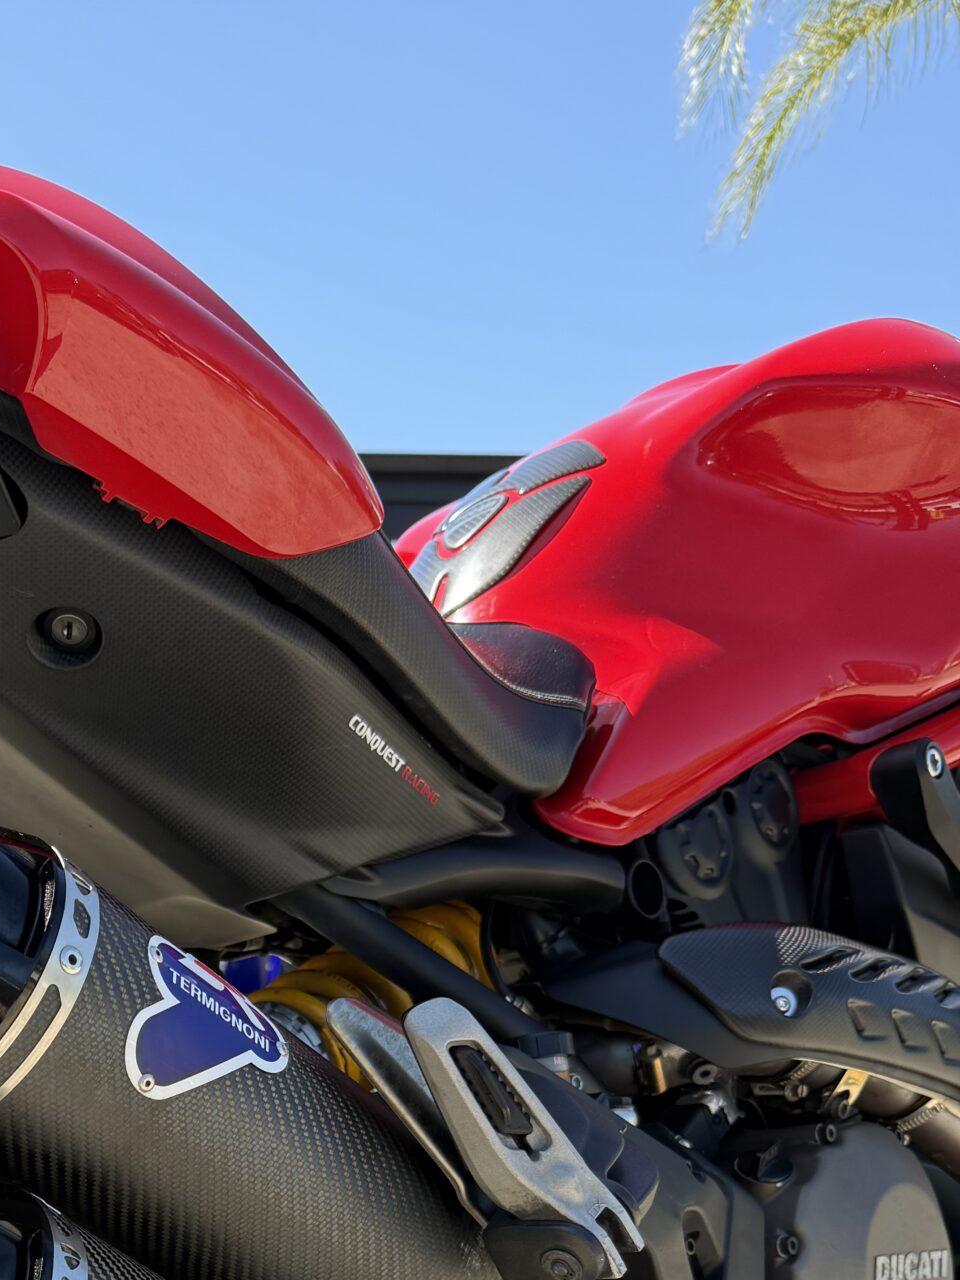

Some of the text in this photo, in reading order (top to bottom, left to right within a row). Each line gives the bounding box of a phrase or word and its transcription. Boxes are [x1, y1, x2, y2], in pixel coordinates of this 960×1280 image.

[348, 714, 440, 806] CONQUEST RACING
[169, 967, 271, 1053] TERMIGNONI
